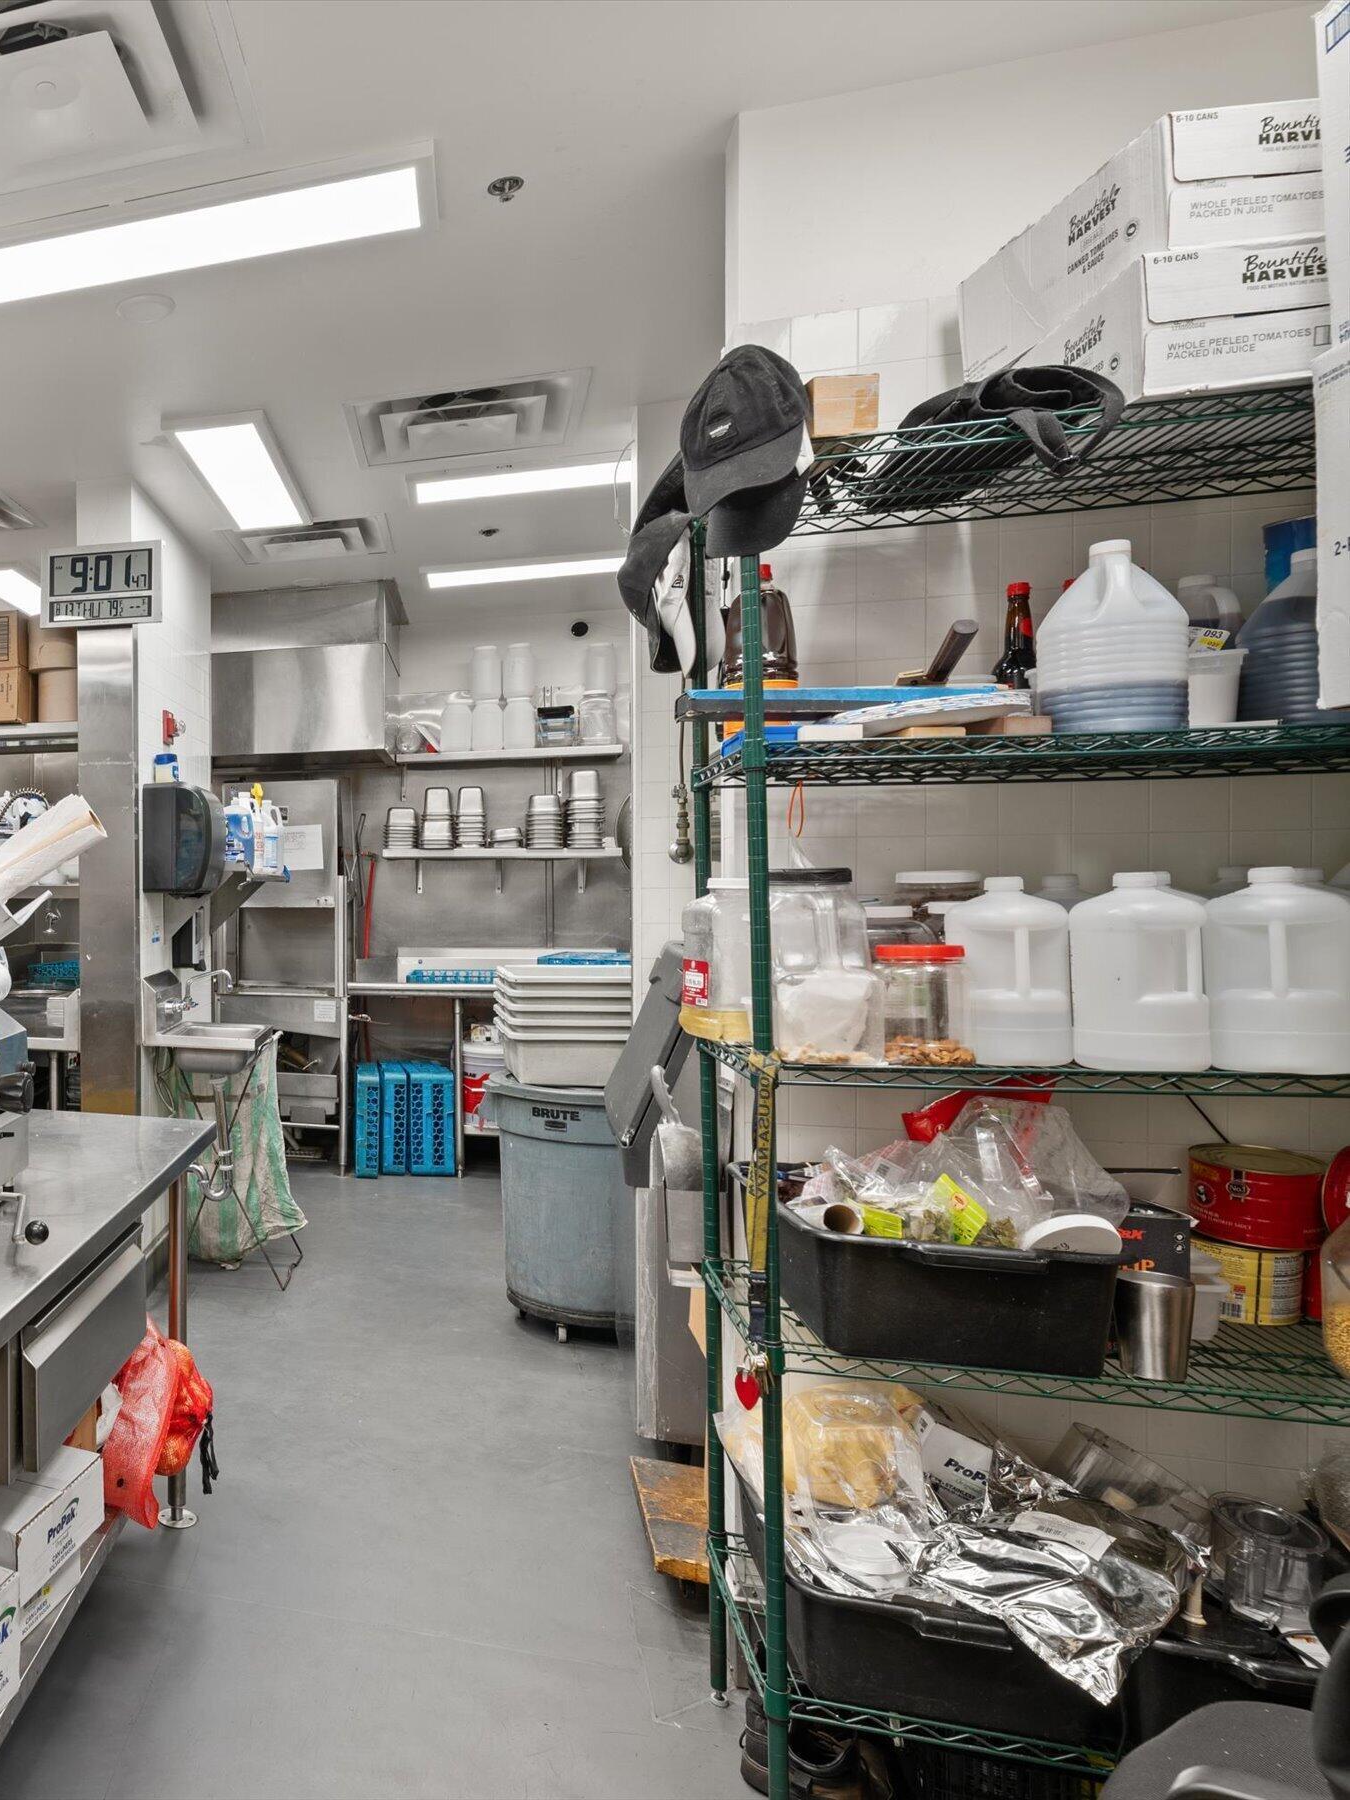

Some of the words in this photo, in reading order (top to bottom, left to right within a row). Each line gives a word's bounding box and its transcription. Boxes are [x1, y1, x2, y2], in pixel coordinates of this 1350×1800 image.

[1197, 112, 1219, 121] CANS
[1069, 182, 1121, 232] Bountiful
[1190, 198, 1228, 210] WHOLE
[1230, 196, 1268, 206] PEELED
[1271, 190, 1325, 203] TOMATOES
[1068, 198, 1117, 247] HARVEST
[1190, 207, 1231, 219] PACKED
[1234, 206, 1244, 215] IN
[1245, 204, 1274, 214] JUICE
[1067, 253, 1089, 275] CANNED
[1089, 228, 1119, 254] TOMATOES
[1087, 250, 1105, 270] SAUCE
[1153, 256, 1173, 265] 6-10
[1175, 252, 1199, 262] CANS
[1244, 246, 1327, 273] Bountifu
[1242, 263, 1328, 285] HARVES
[1063, 330, 1102, 367] HARVEST
[1168, 340, 1206, 351] WHOLE
[1209, 335, 1249, 347] PEELED
[1253, 328, 1312, 342] TOMATOES
[1167, 349, 1209, 360] PACKED
[1226, 344, 1256, 354] JUICE
[70, 554, 132, 594] 9:01
[1203, 629, 1224, 639] 093
[531, 1106, 582, 1122] BRUTE
[46, 1506, 77, 1545] ProPak
